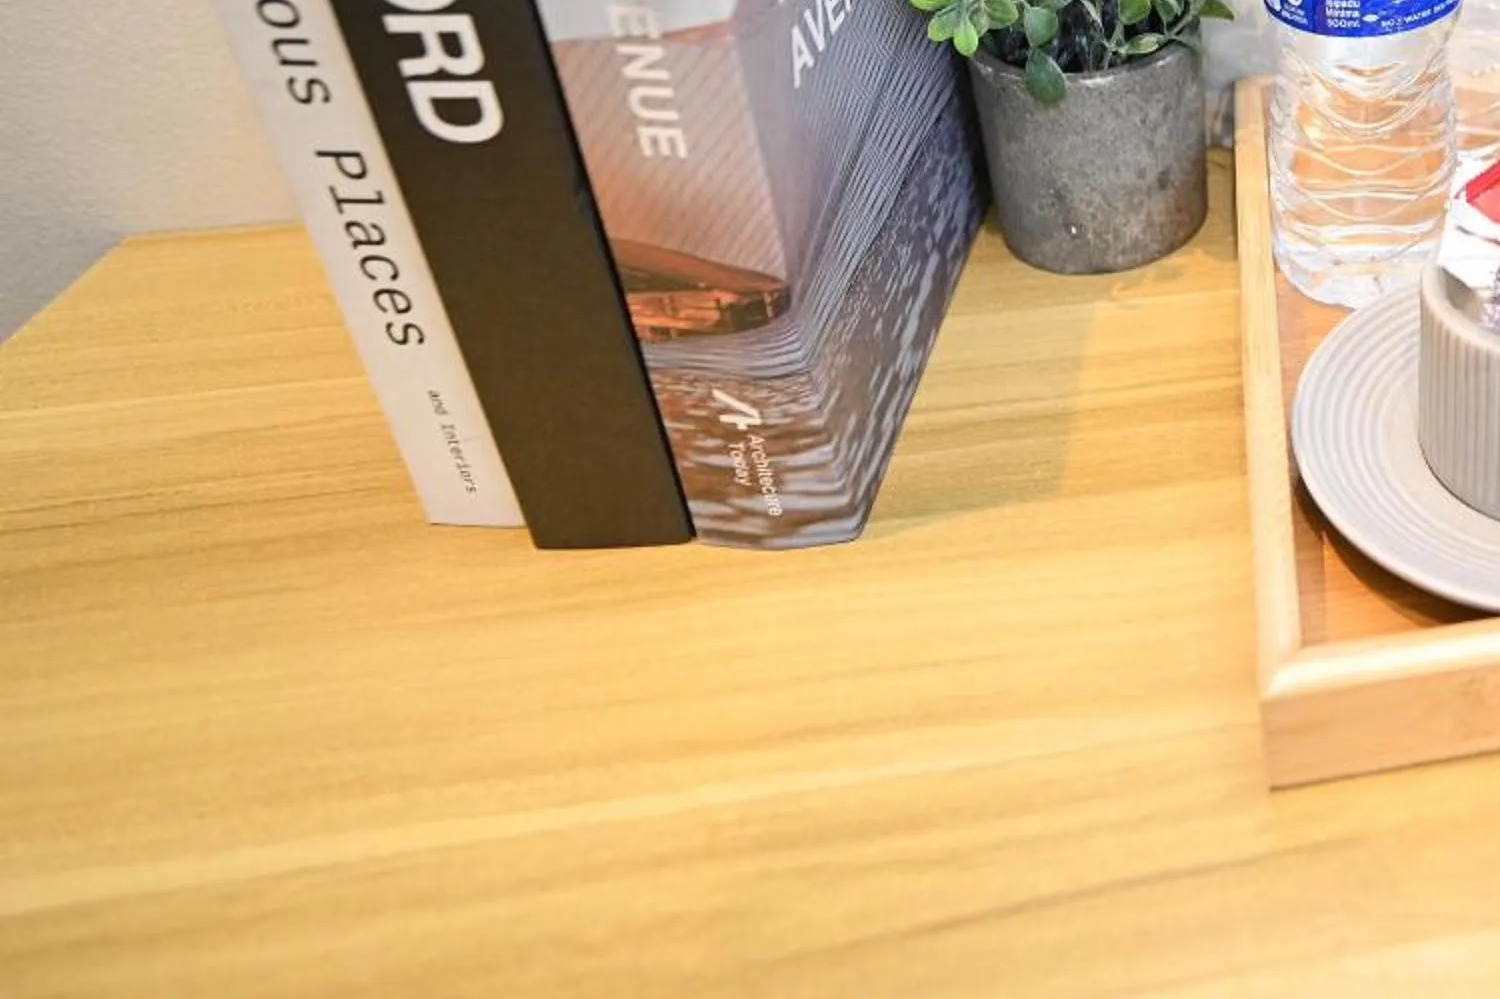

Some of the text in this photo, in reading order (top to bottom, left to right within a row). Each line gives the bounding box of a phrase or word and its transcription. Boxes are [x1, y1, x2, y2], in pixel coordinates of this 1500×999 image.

[315, 148, 426, 347] Places
[427, 390, 478, 494] and Interiors
[728, 442, 753, 486] Today
[747, 434, 783, 517] Architecture
